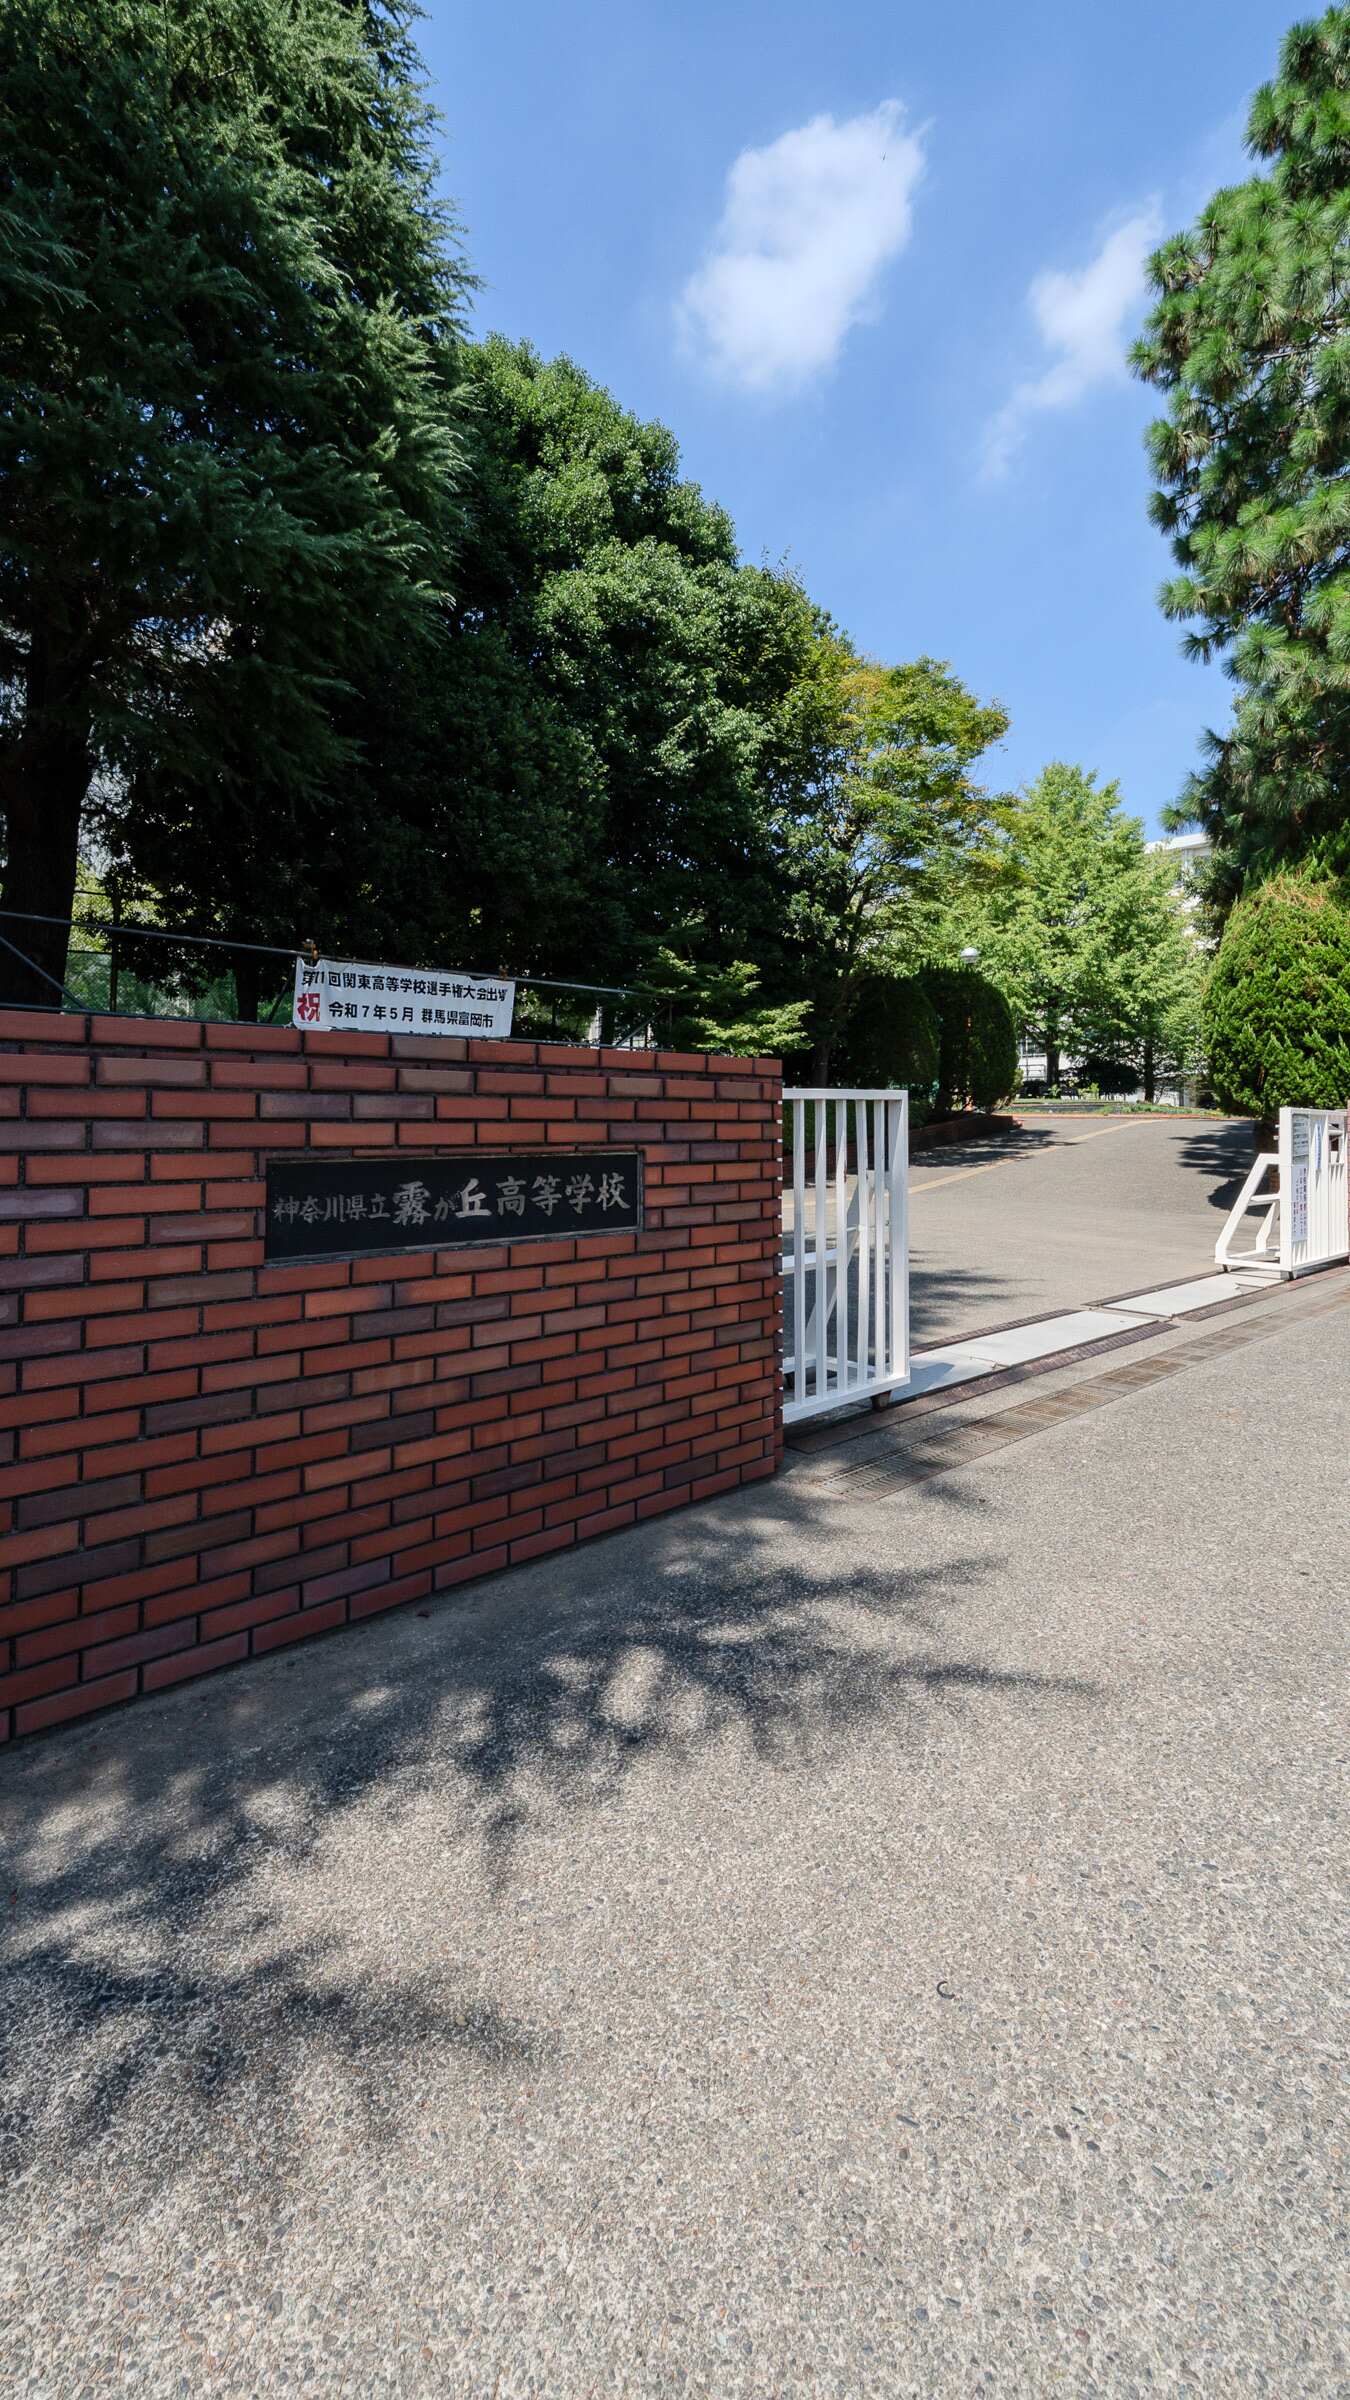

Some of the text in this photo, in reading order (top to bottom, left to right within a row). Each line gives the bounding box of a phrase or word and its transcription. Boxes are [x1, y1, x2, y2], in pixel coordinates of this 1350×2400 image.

[297, 993, 320, 1021] 祝
[421, 1008, 494, 1028] 群馬県富岡市
[273, 1172, 631, 1226] 神奈川県立霧が丘高等学校
